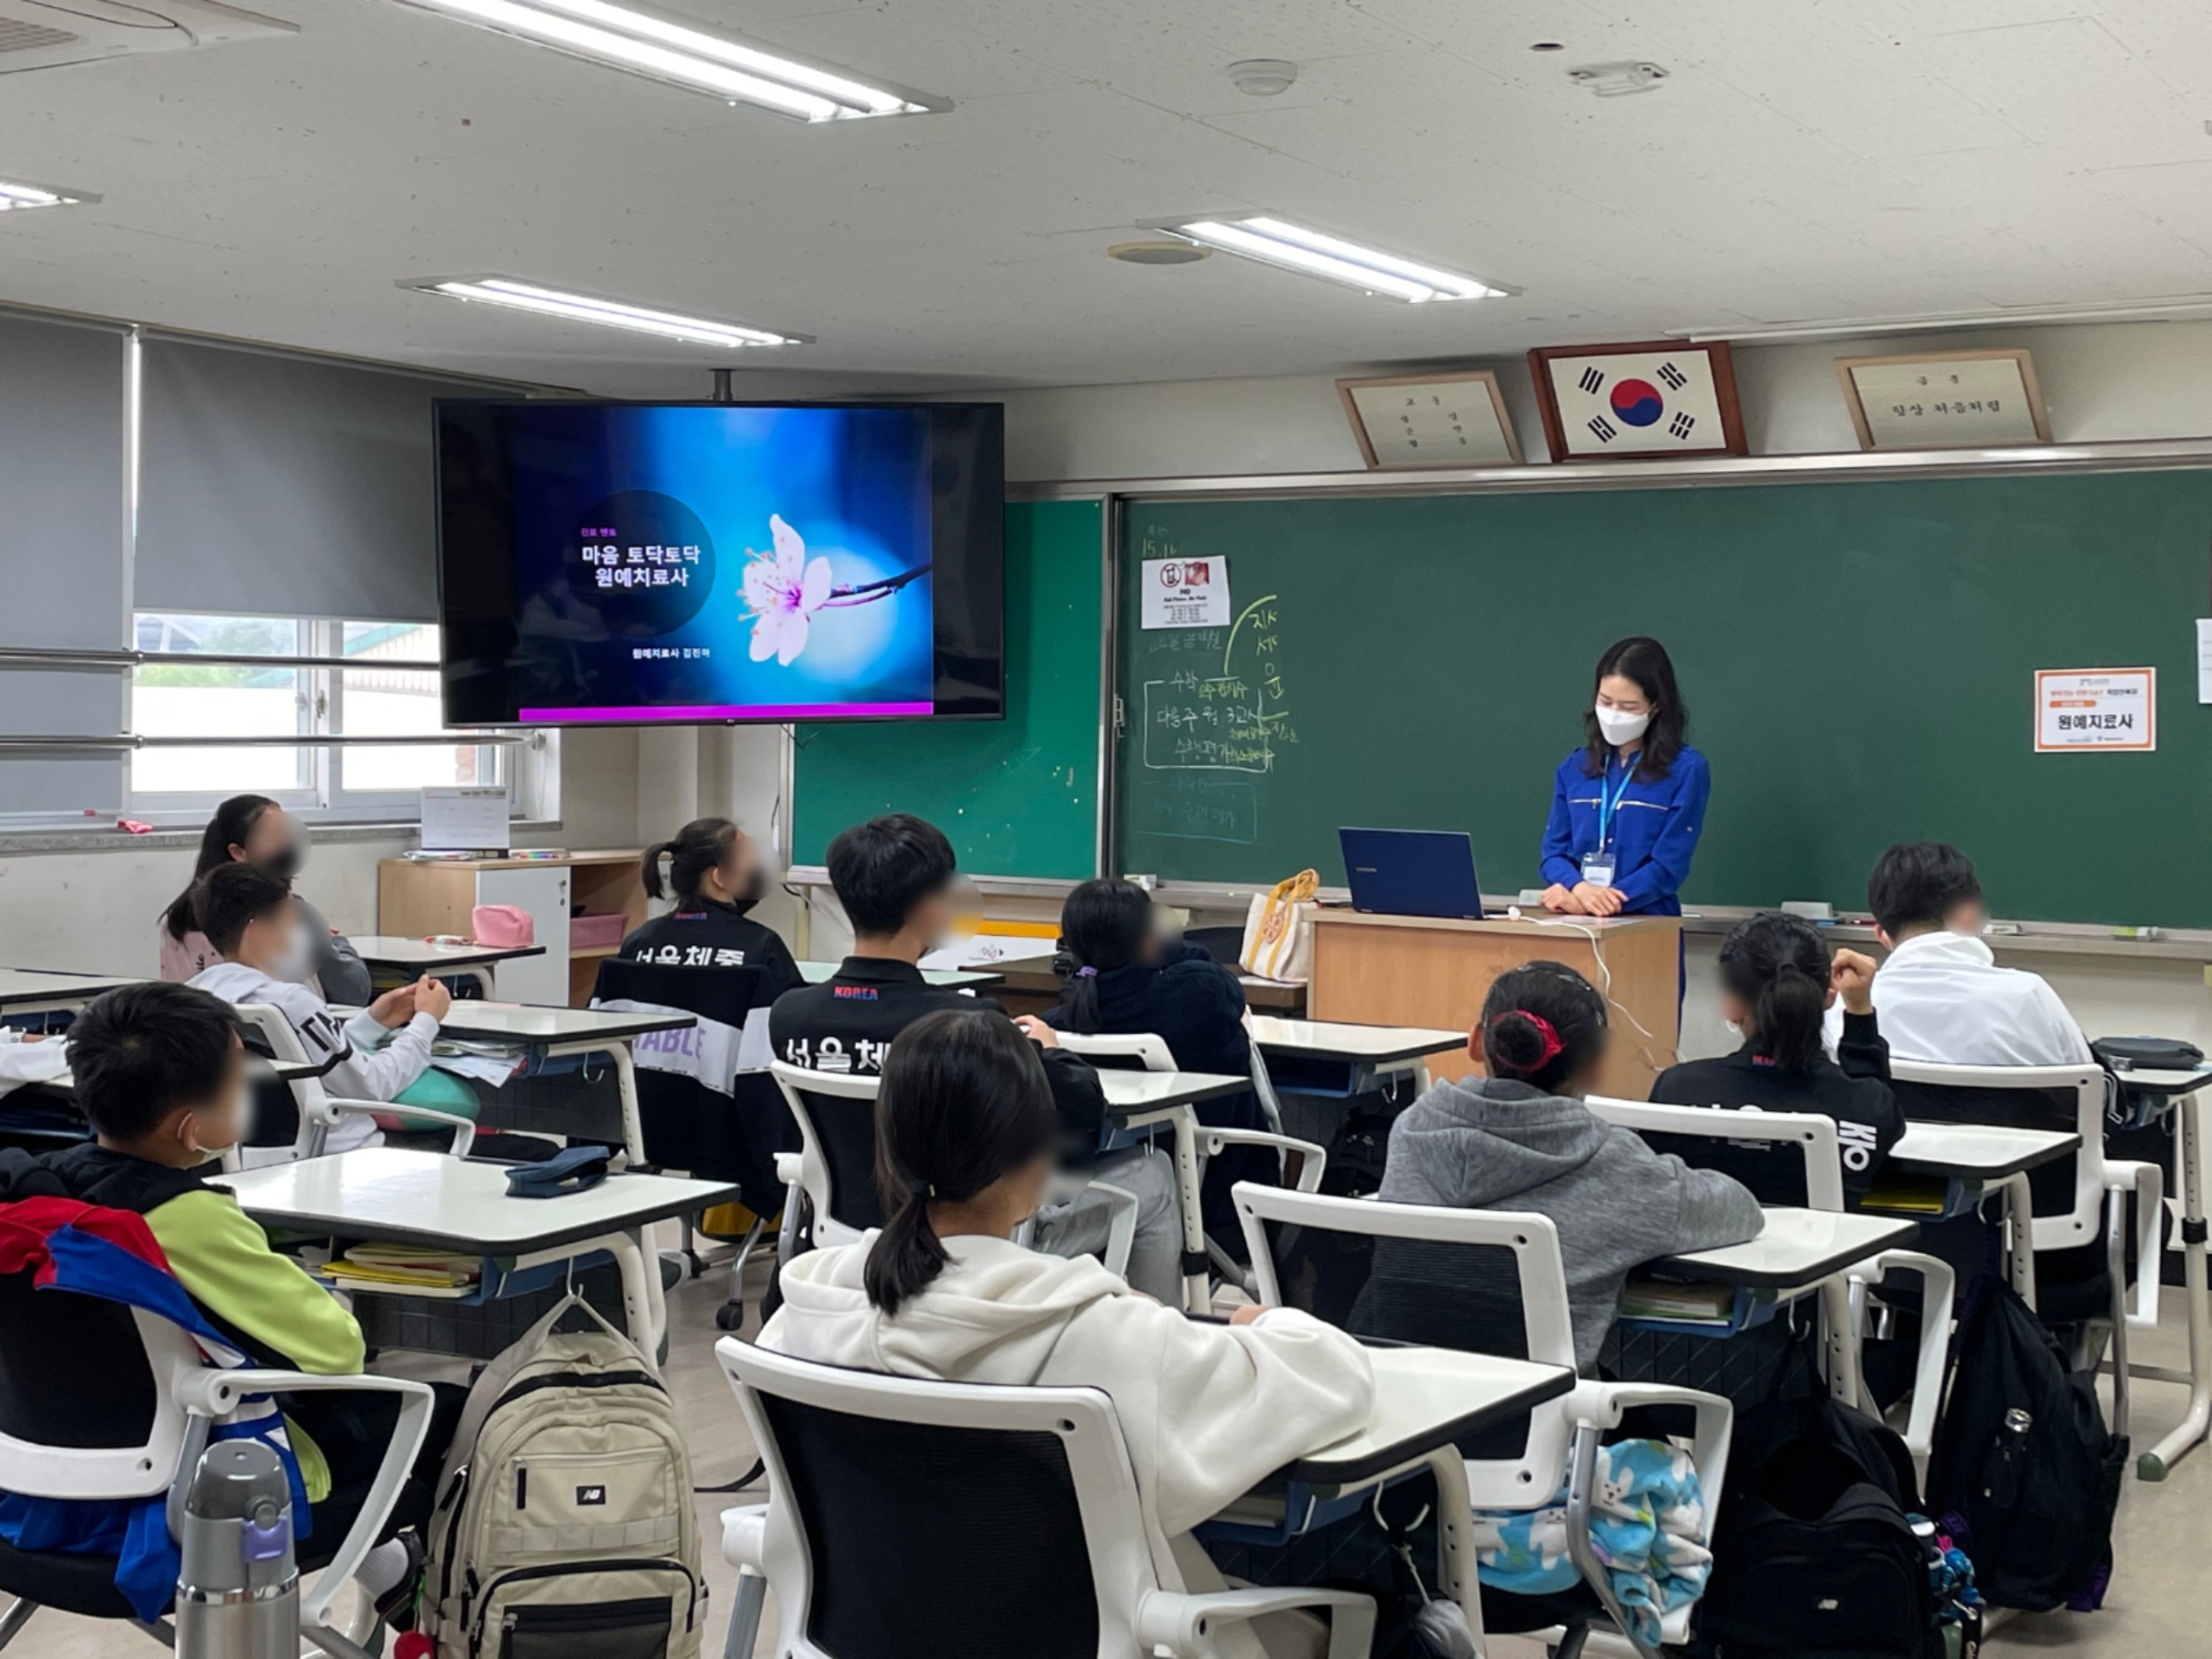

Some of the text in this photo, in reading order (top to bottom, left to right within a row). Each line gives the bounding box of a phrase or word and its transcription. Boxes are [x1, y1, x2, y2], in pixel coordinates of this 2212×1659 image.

[582, 545, 701, 565] 마음 토닥토닥
[595, 568, 689, 587] 원예치료사
[633, 647, 680, 659] 원예치료사
[2058, 713, 2133, 730] 원예치료사
[834, 985, 879, 1001] KOREA
